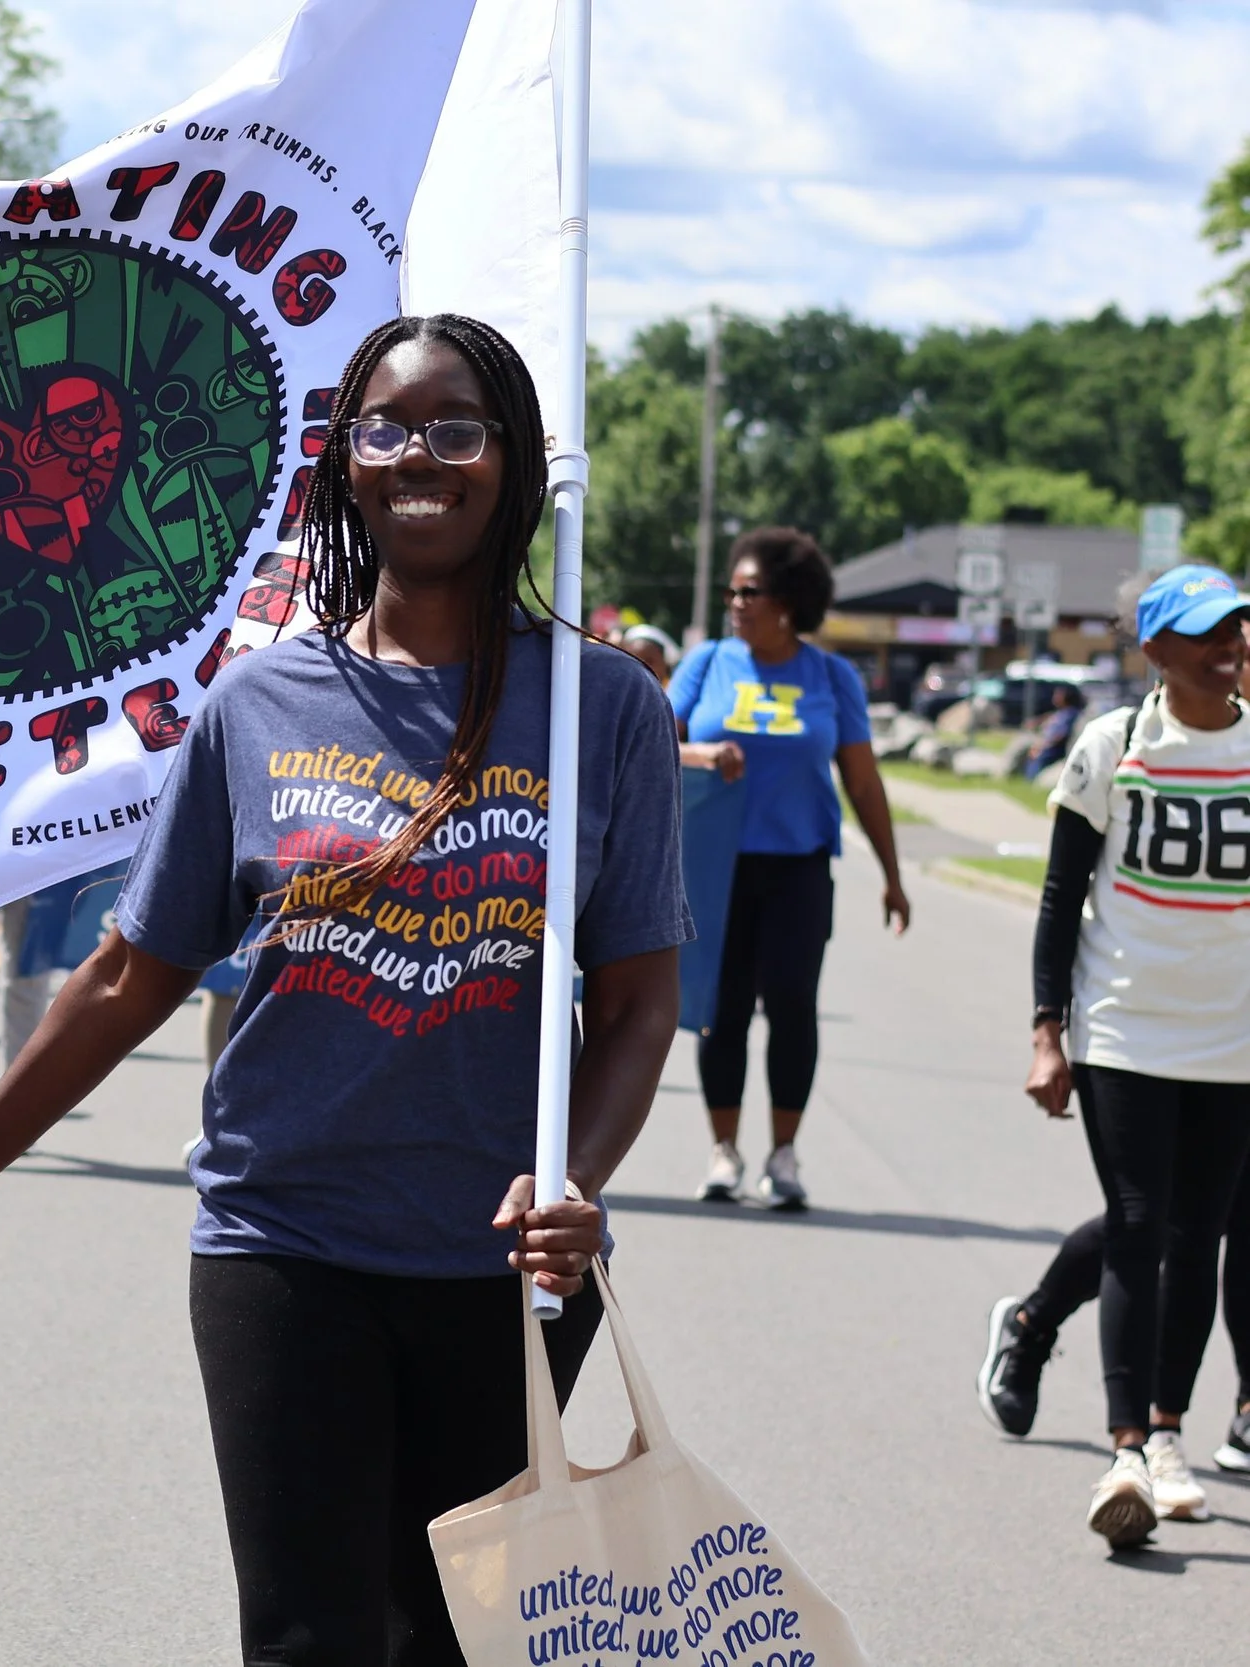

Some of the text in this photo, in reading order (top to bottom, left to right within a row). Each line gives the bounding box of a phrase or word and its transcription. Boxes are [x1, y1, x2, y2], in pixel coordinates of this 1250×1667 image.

[184, 122, 230, 142] OUR
[351, 195, 403, 266] BLACK
[723, 681, 805, 736] H
[380, 770, 431, 809] we
[433, 813, 477, 855] do
[432, 860, 476, 901] do
[374, 900, 425, 943] we
[429, 904, 472, 948] do
[370, 947, 421, 992] we
[422, 952, 463, 996] do
[367, 992, 413, 1038] we
[620, 1584, 663, 1617] we
[667, 1563, 697, 1607] do
[690, 1521, 769, 1574] more.
[636, 1628, 680, 1660] we
[683, 1605, 712, 1649] do
[705, 1563, 784, 1616] more.
[722, 1607, 801, 1661] more.
